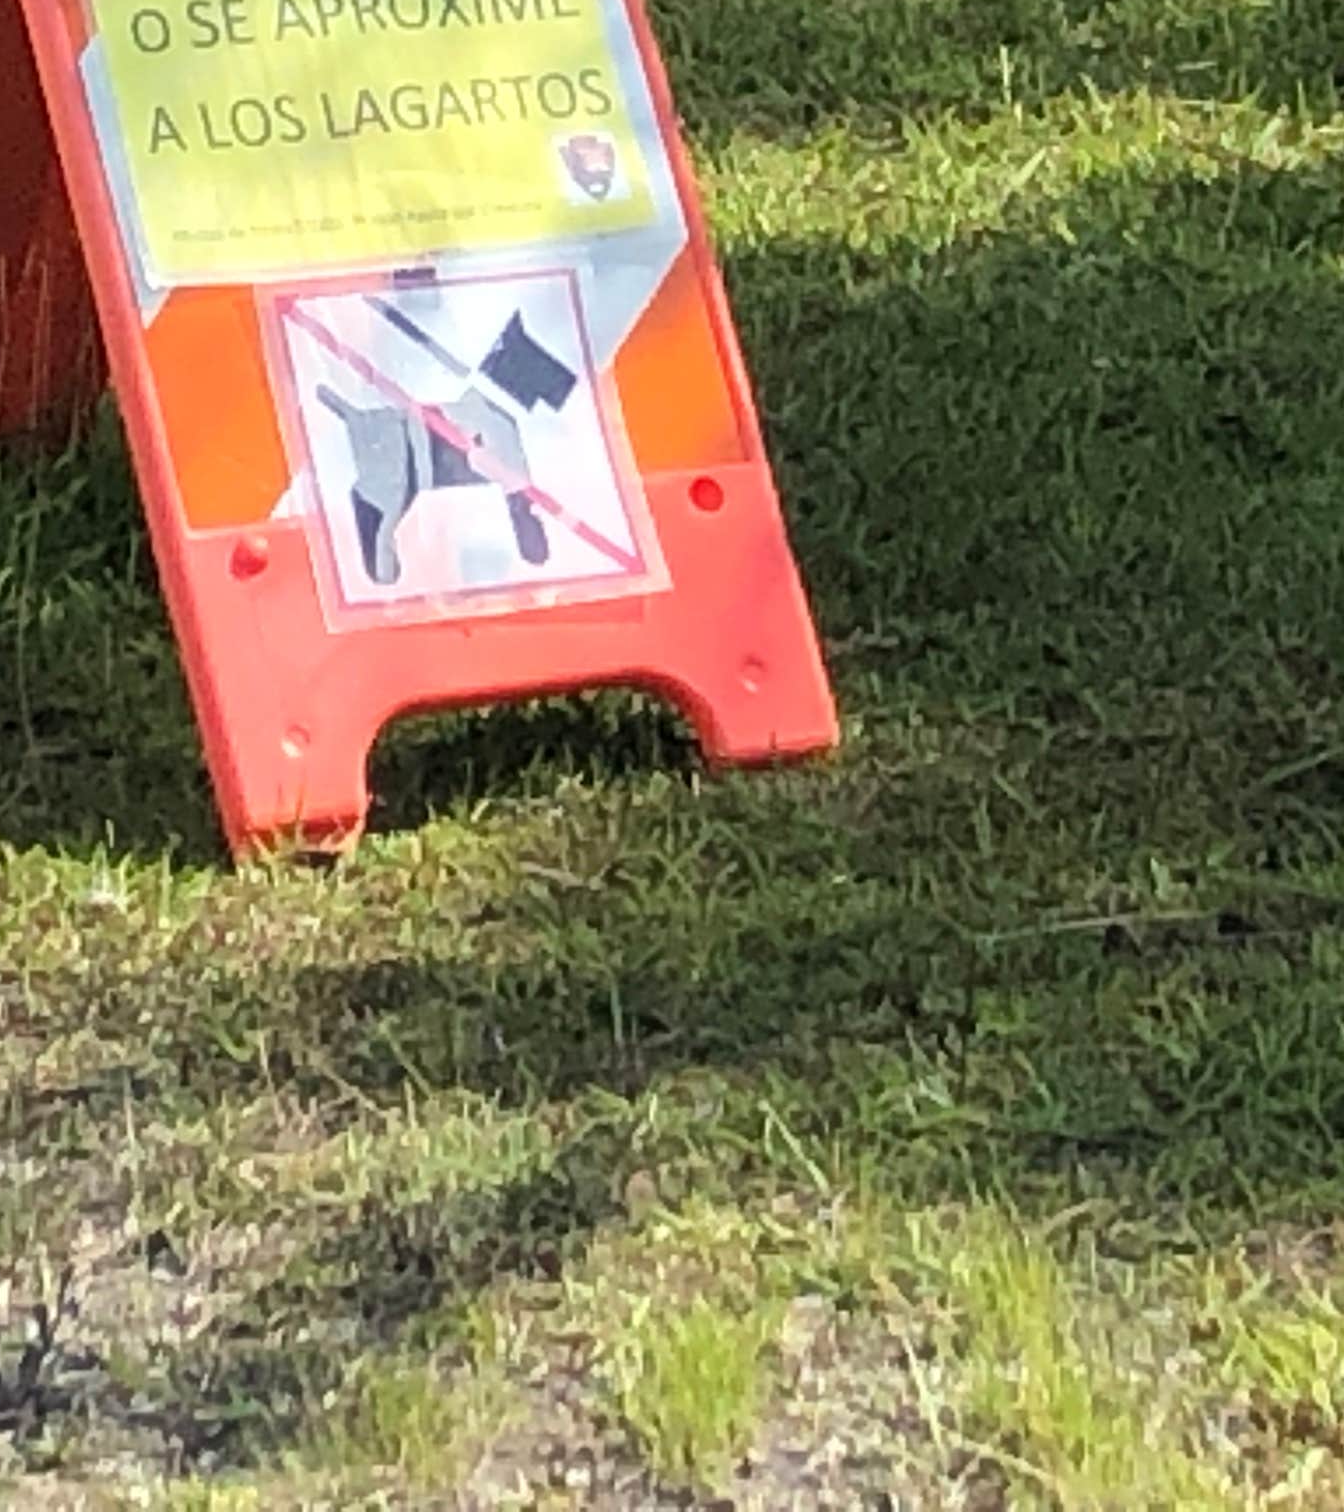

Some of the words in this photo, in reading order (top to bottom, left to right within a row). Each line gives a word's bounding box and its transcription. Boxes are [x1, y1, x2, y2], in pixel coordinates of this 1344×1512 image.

[131, 9, 170, 53] O
[148, 107, 187, 153] A
[199, 97, 307, 150] LOS
[322, 69, 613, 139] LAGARTOS
